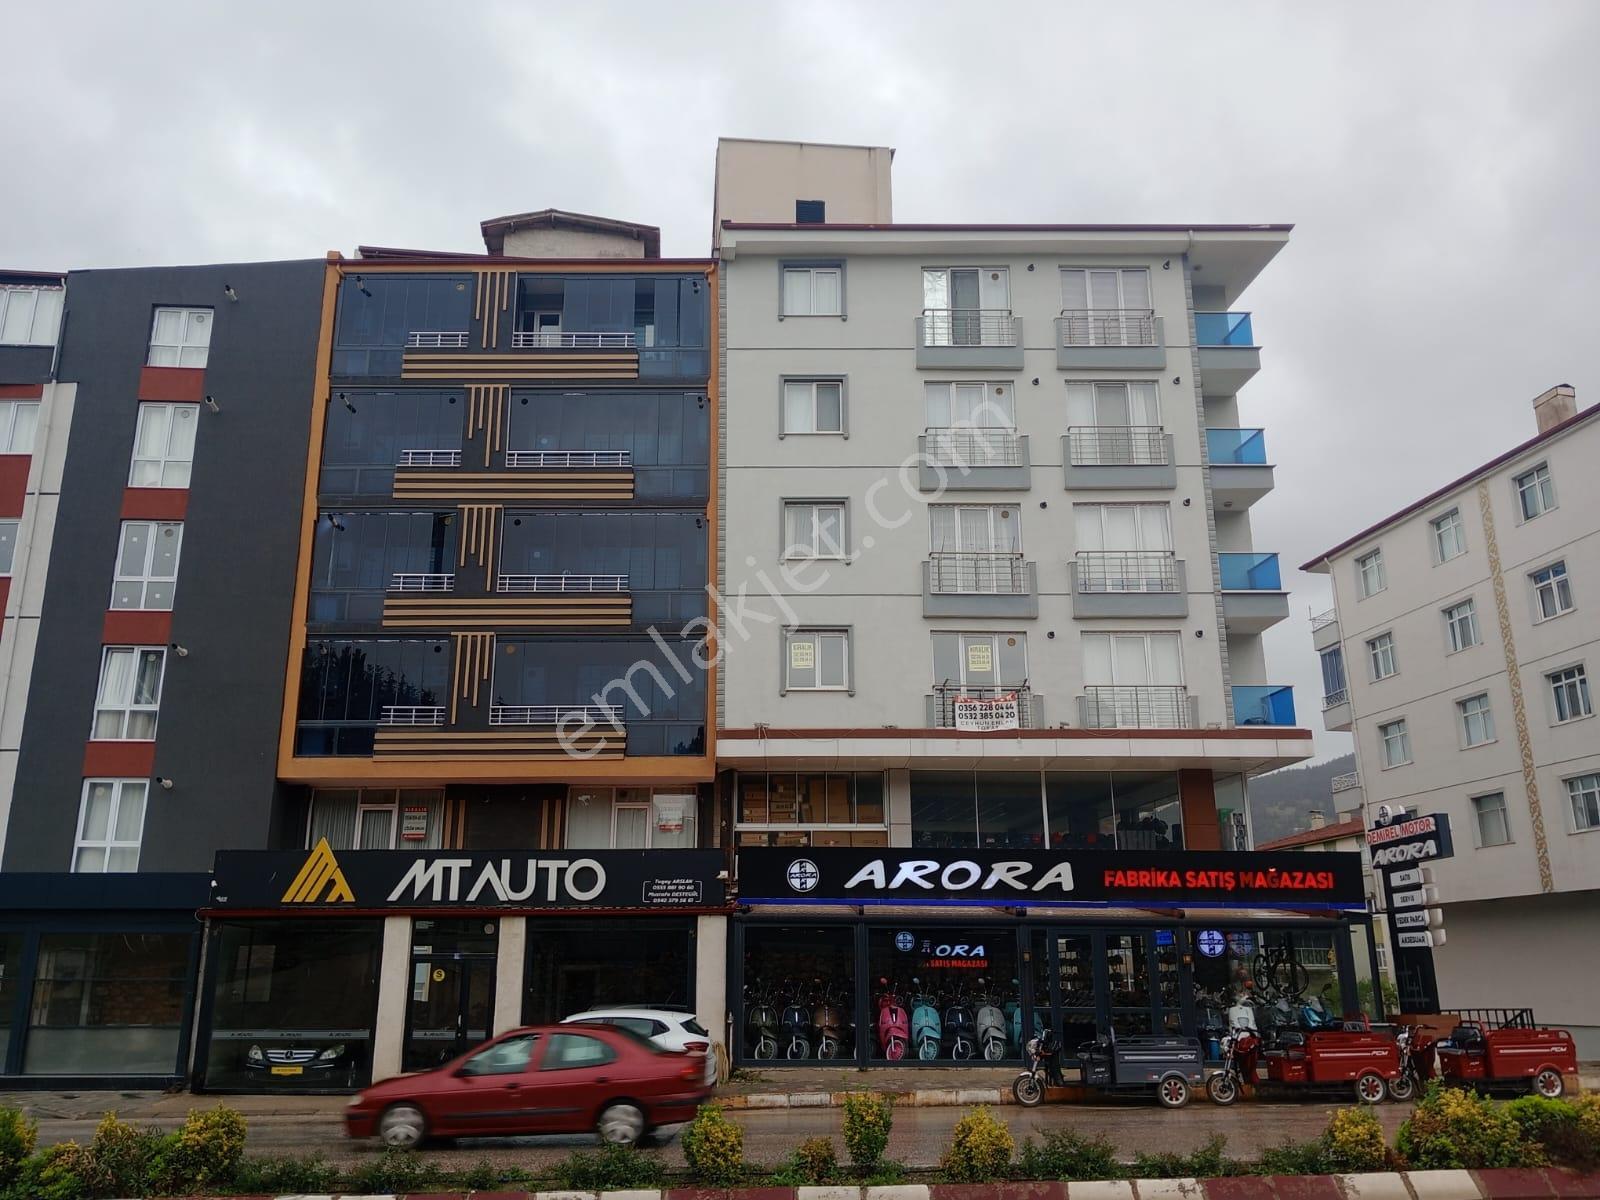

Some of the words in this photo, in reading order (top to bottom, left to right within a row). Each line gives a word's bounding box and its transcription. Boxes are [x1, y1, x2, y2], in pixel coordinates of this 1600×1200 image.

[979, 703, 994, 711] 228
[1005, 711, 1016, 719] 20
[1400, 818, 1432, 836] MOTOR
[1373, 840, 1437, 866] ARORA
[844, 859, 1074, 892] ARORA
[1103, 866, 1182, 890] FABRİKA
[1185, 870, 1236, 891] SATIŞ
[1239, 867, 1334, 890] MAĞAZASI
